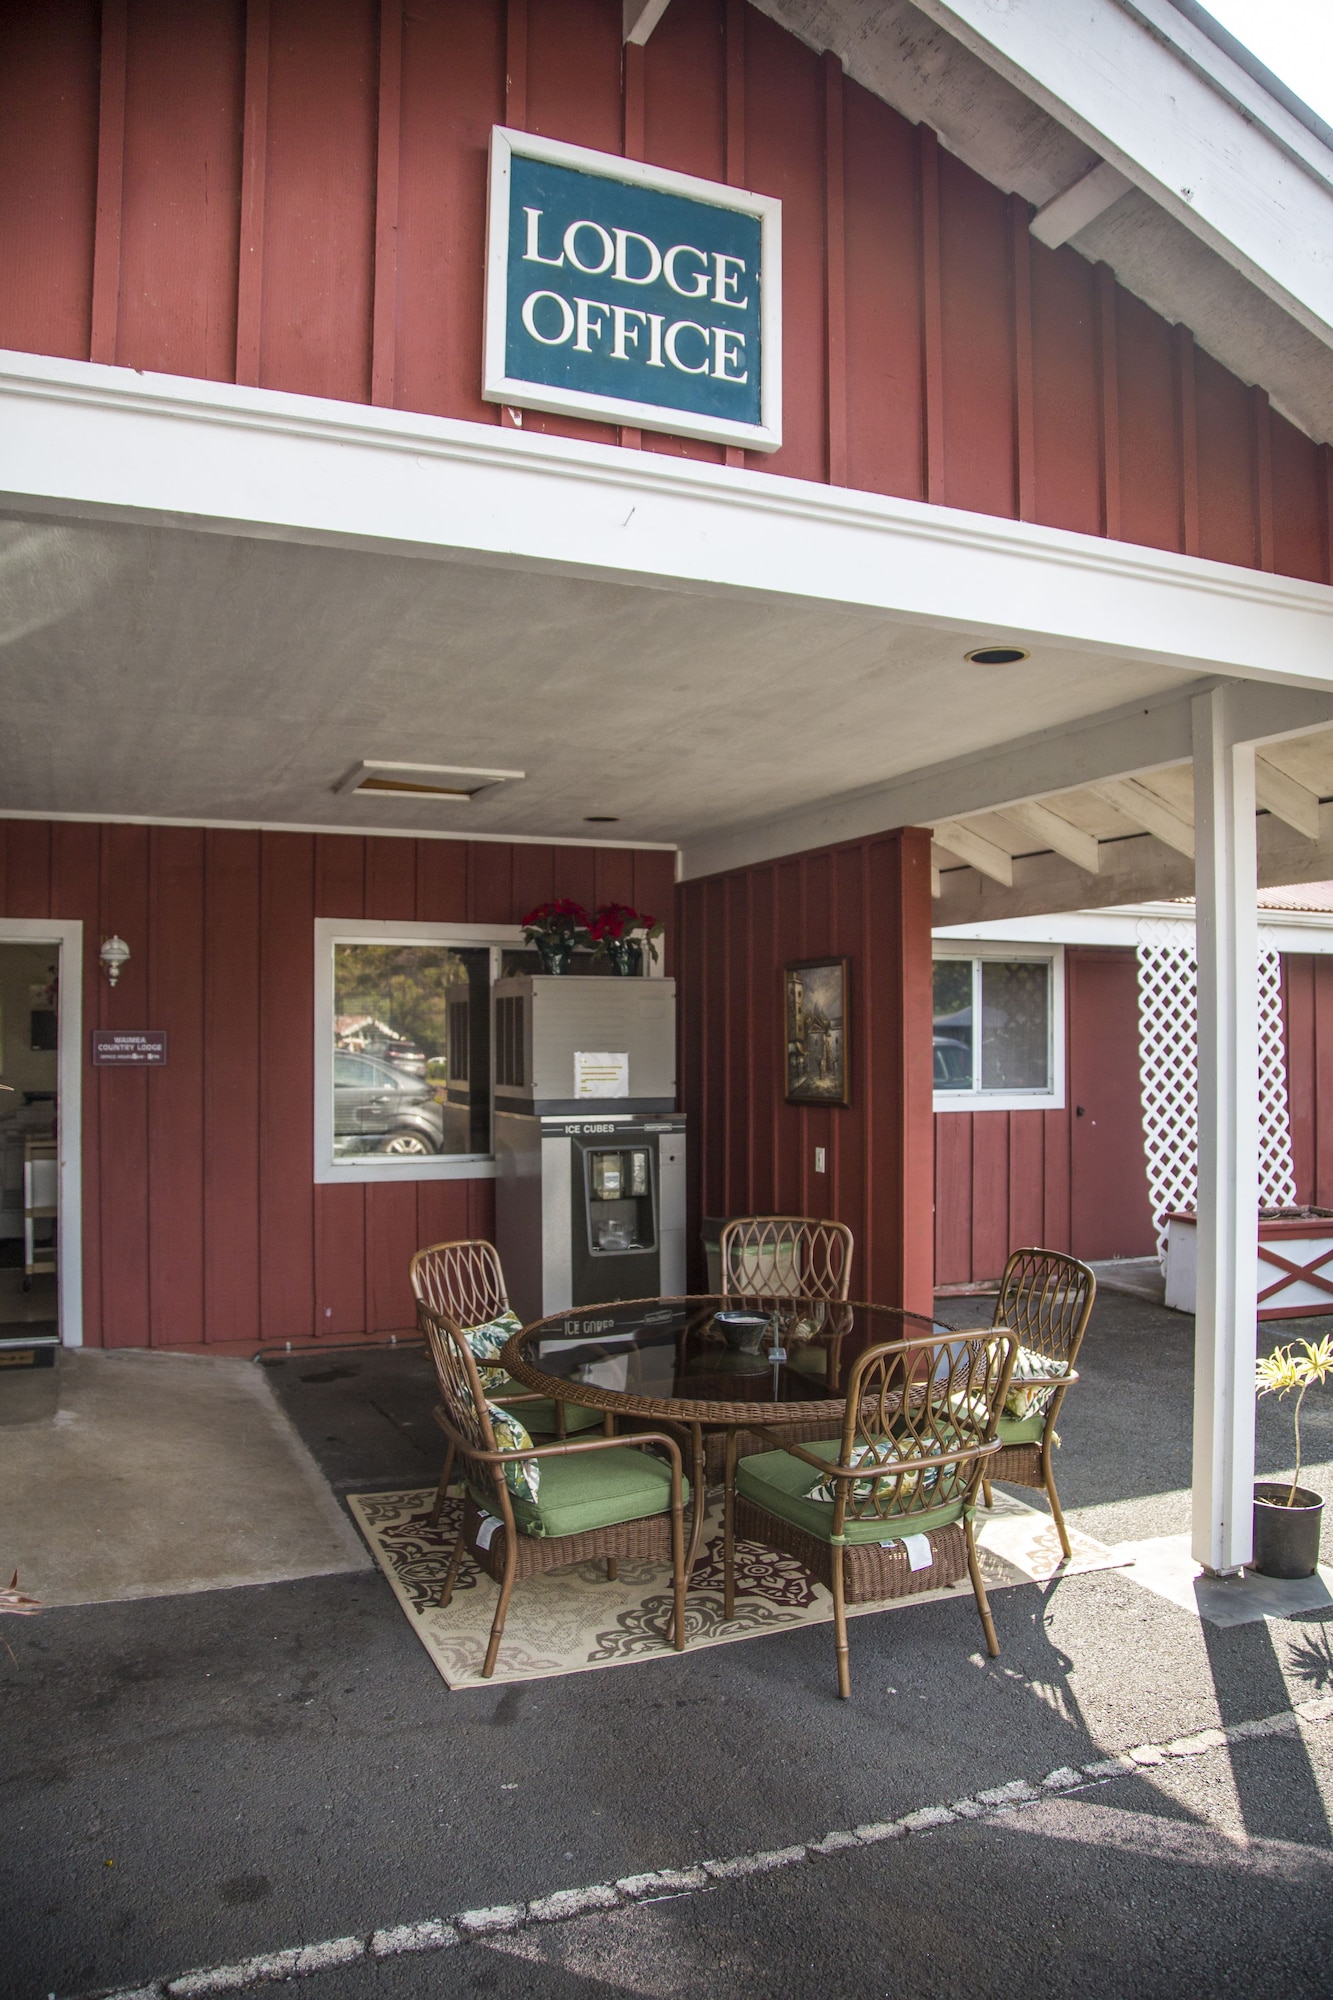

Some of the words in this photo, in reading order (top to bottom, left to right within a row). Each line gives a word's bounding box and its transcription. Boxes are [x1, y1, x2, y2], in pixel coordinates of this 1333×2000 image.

[521, 206, 748, 310] LODGE
[521, 290, 748, 385] OFFICE
[564, 1125, 581, 1134] ICE
[583, 1124, 615, 1133] CUBES
